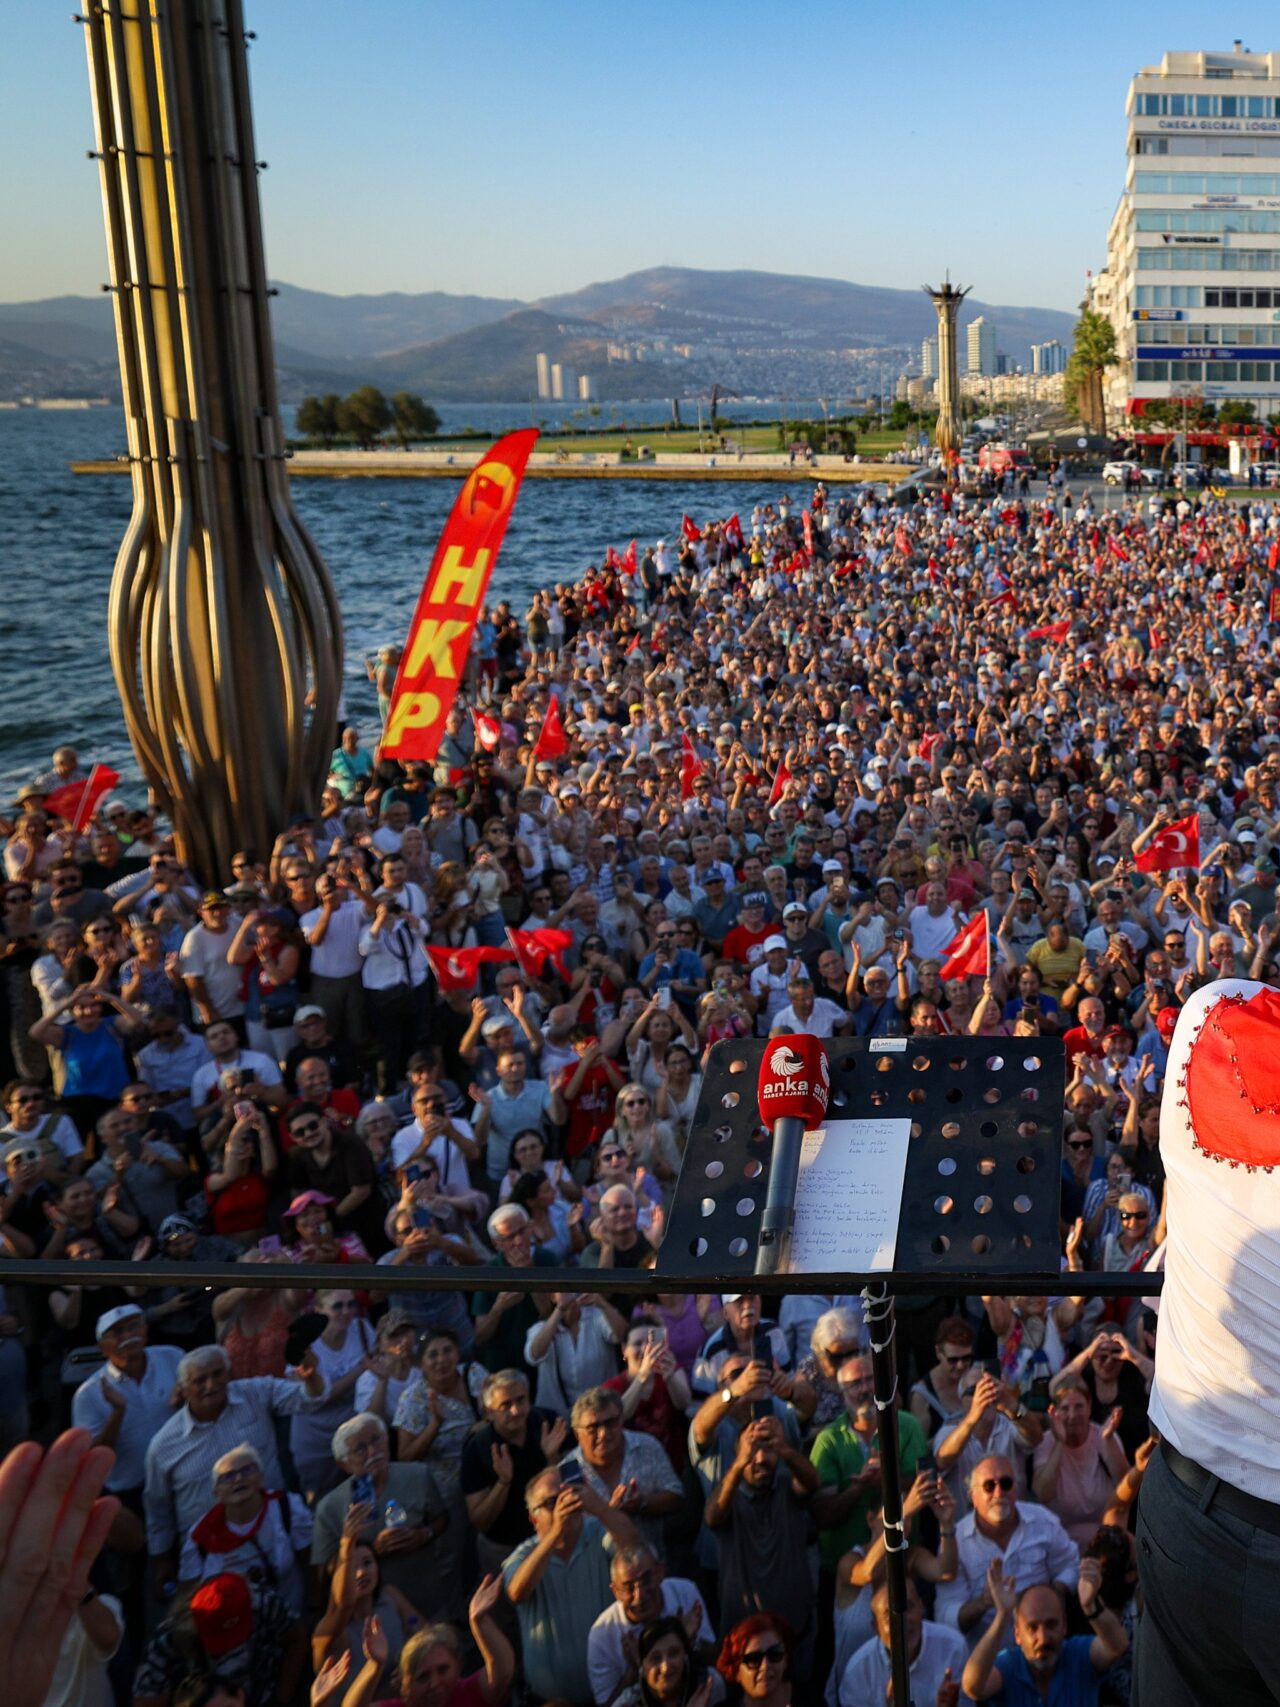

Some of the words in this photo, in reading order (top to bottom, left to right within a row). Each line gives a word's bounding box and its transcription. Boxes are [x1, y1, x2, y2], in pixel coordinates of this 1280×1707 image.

[1158, 120, 1197, 129] OMEGA
[1200, 121, 1241, 130] GLOBAL
[383, 545, 491, 748] HKP
[763, 1076, 809, 1094] anka
